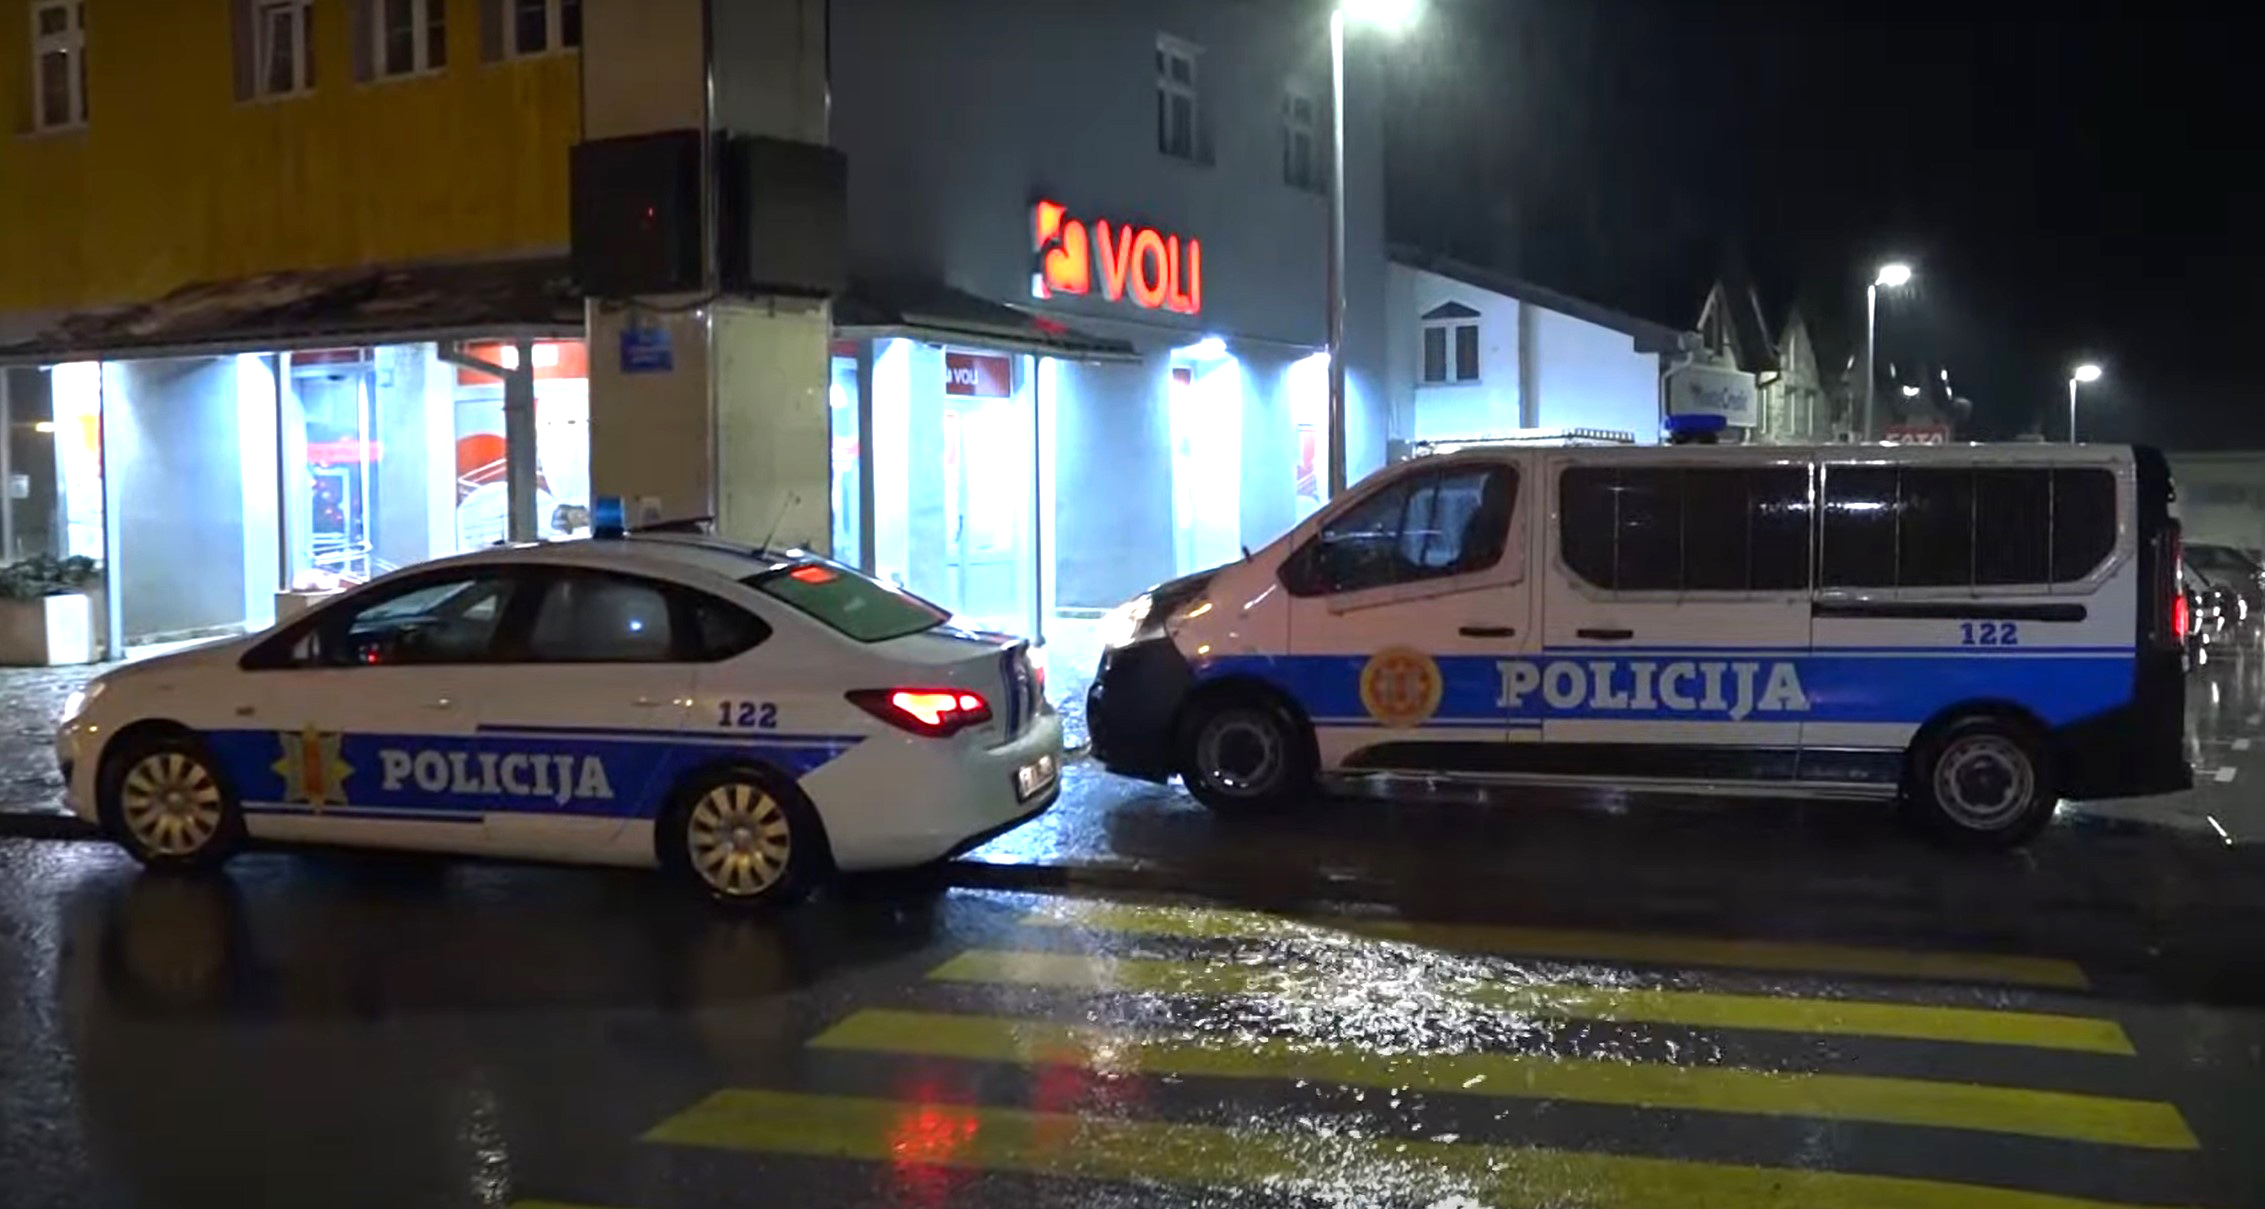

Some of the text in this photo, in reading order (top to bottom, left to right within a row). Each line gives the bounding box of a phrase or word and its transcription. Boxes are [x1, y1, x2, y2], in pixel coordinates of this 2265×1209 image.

[1096, 219, 1201, 314] VOLI
[1960, 622, 2018, 645] 122
[718, 701, 777, 728] 122
[1496, 660, 1811, 721] POLICIJA
[379, 749, 614, 806] POLICIJA
